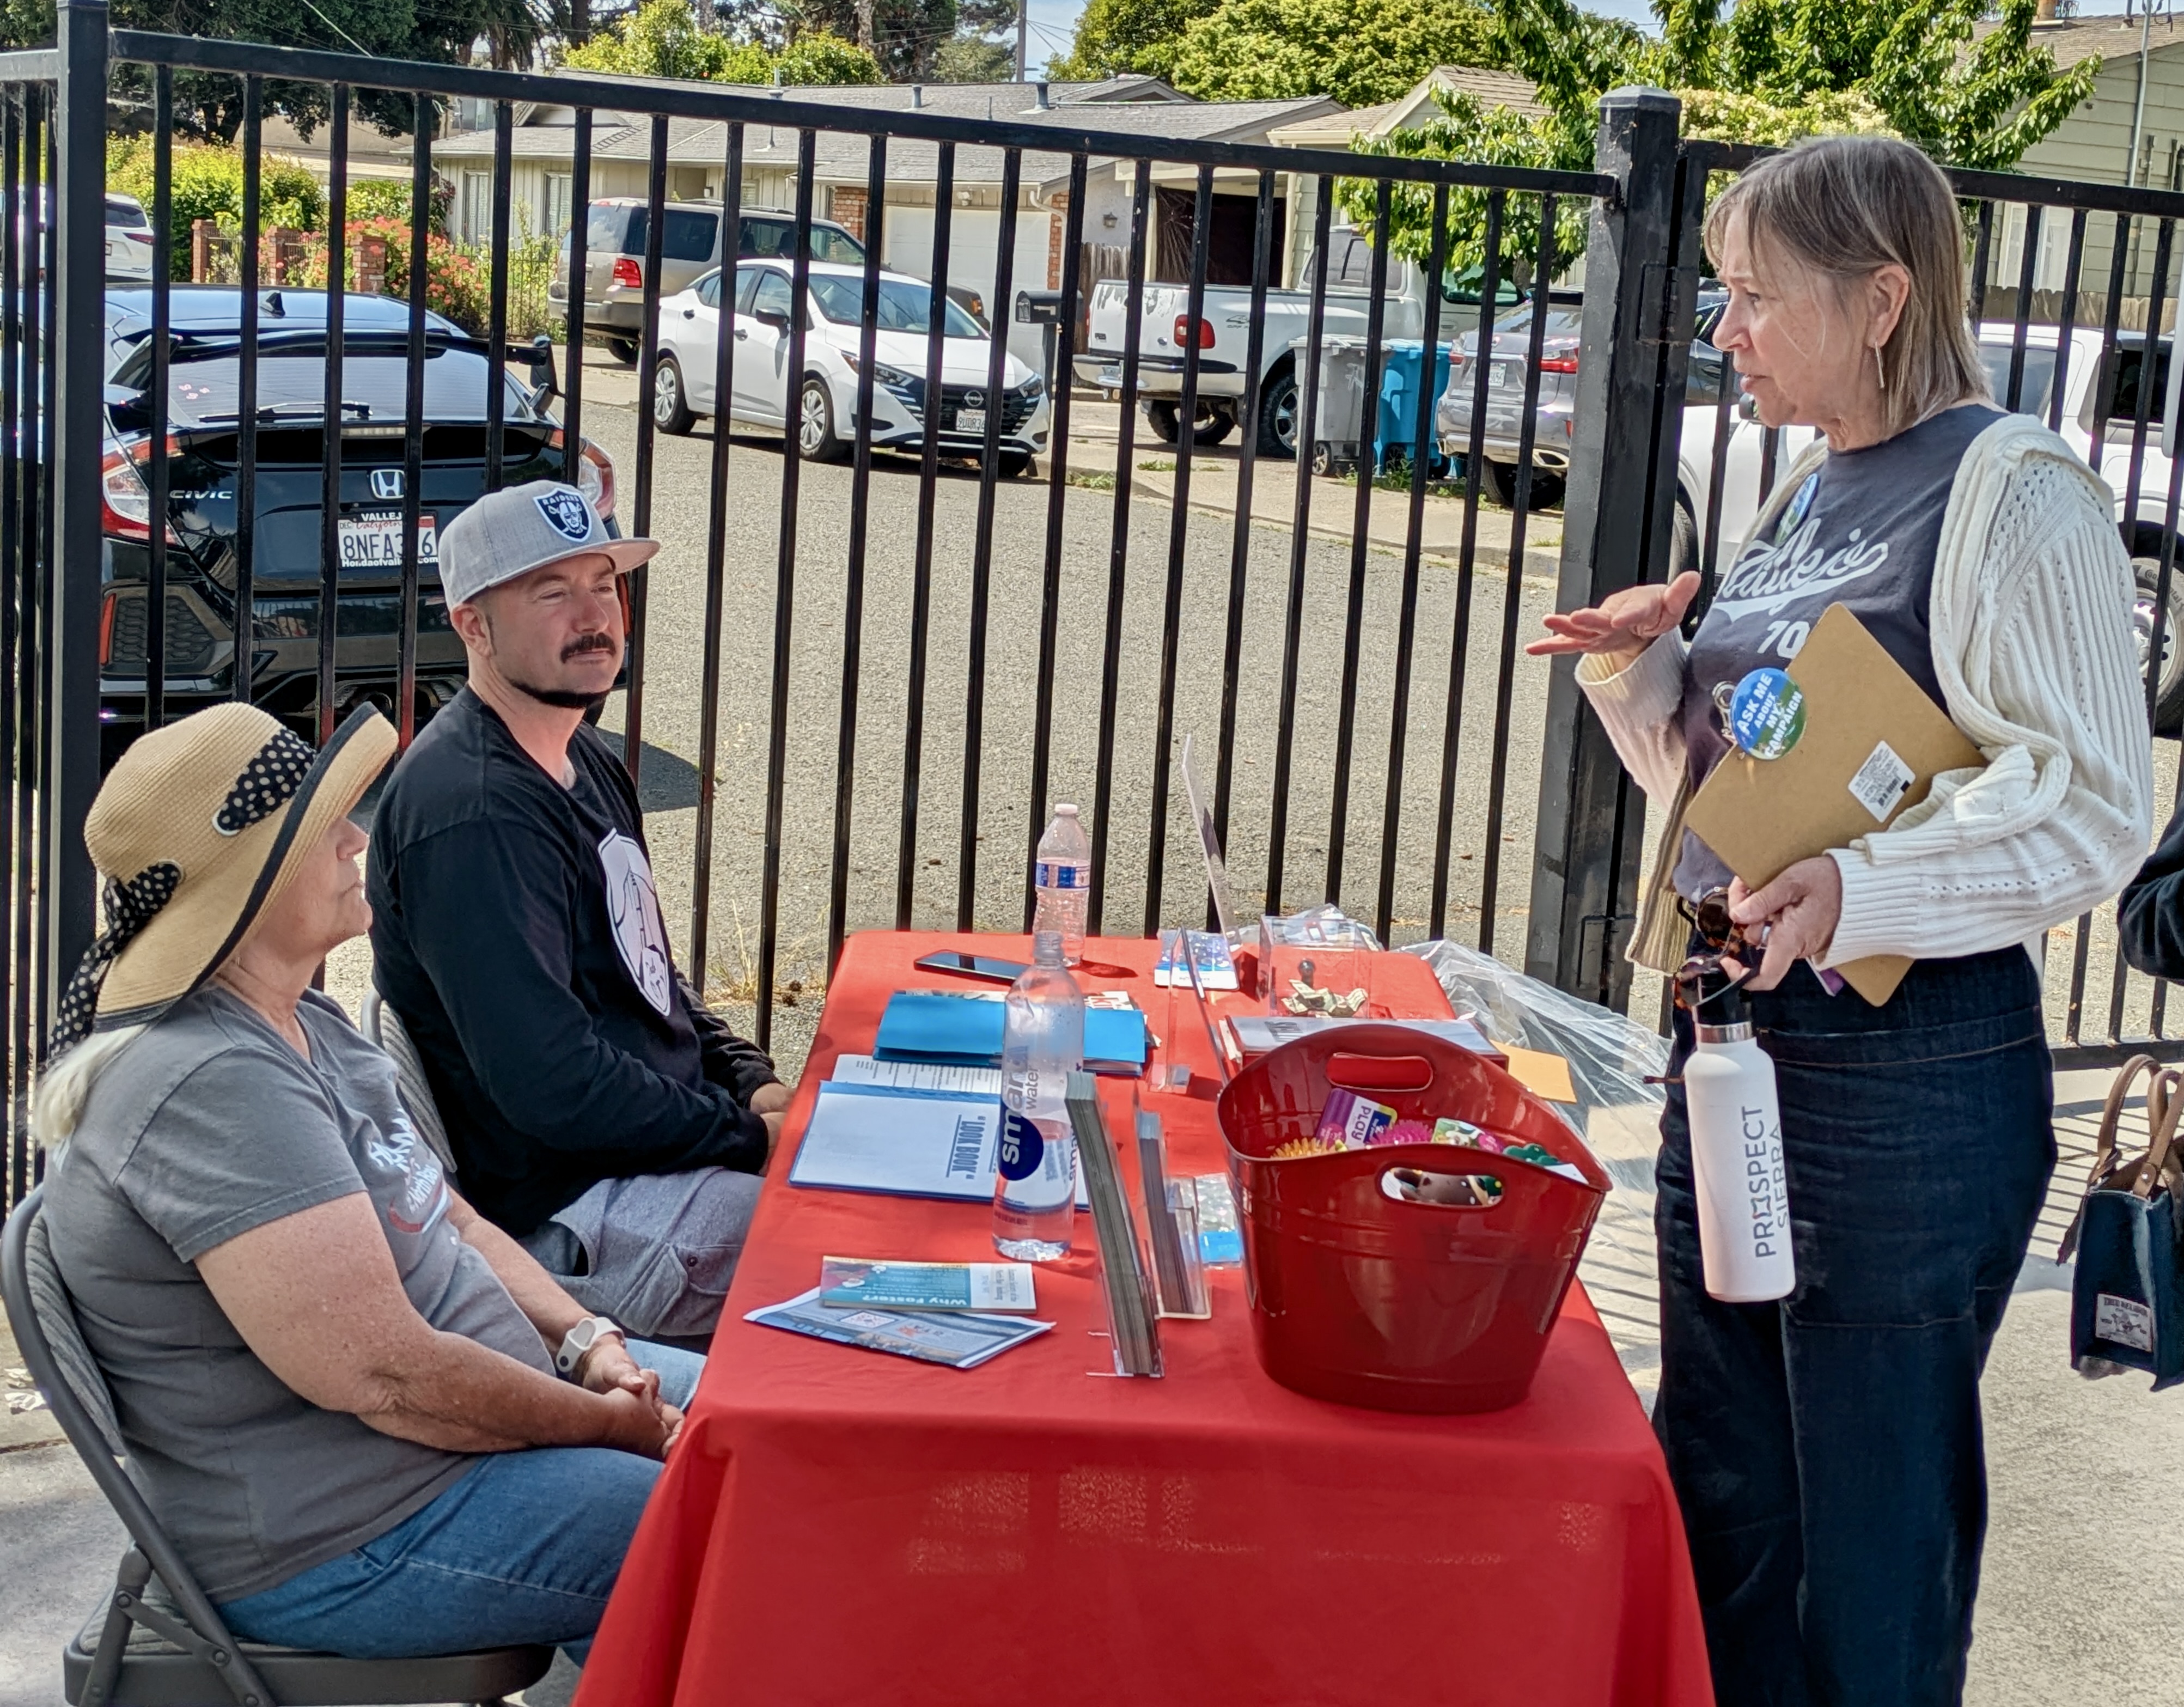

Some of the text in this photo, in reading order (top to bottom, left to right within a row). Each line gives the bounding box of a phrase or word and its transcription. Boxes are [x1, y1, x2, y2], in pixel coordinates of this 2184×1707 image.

[169, 490, 233, 499] CIVIC
[339, 521, 352, 529] DEC
[356, 520, 402, 532] Californ
[361, 512, 402, 522] VALLEJ
[343, 530, 433, 560] 8NFA36
[341, 556, 439, 568] Hondaofvallcom
[1757, 620, 1811, 660] 70
[1737, 672, 1773, 735] ASK ME
[1754, 691, 1776, 729] ABOUT
[1766, 702, 1782, 728] MY
[1764, 691, 1803, 757] CAMPAIGN
[1026, 1064, 1039, 1111] water
[1002, 1057, 1028, 1165] smar
[862, 1294, 967, 1305] Why Foster?
